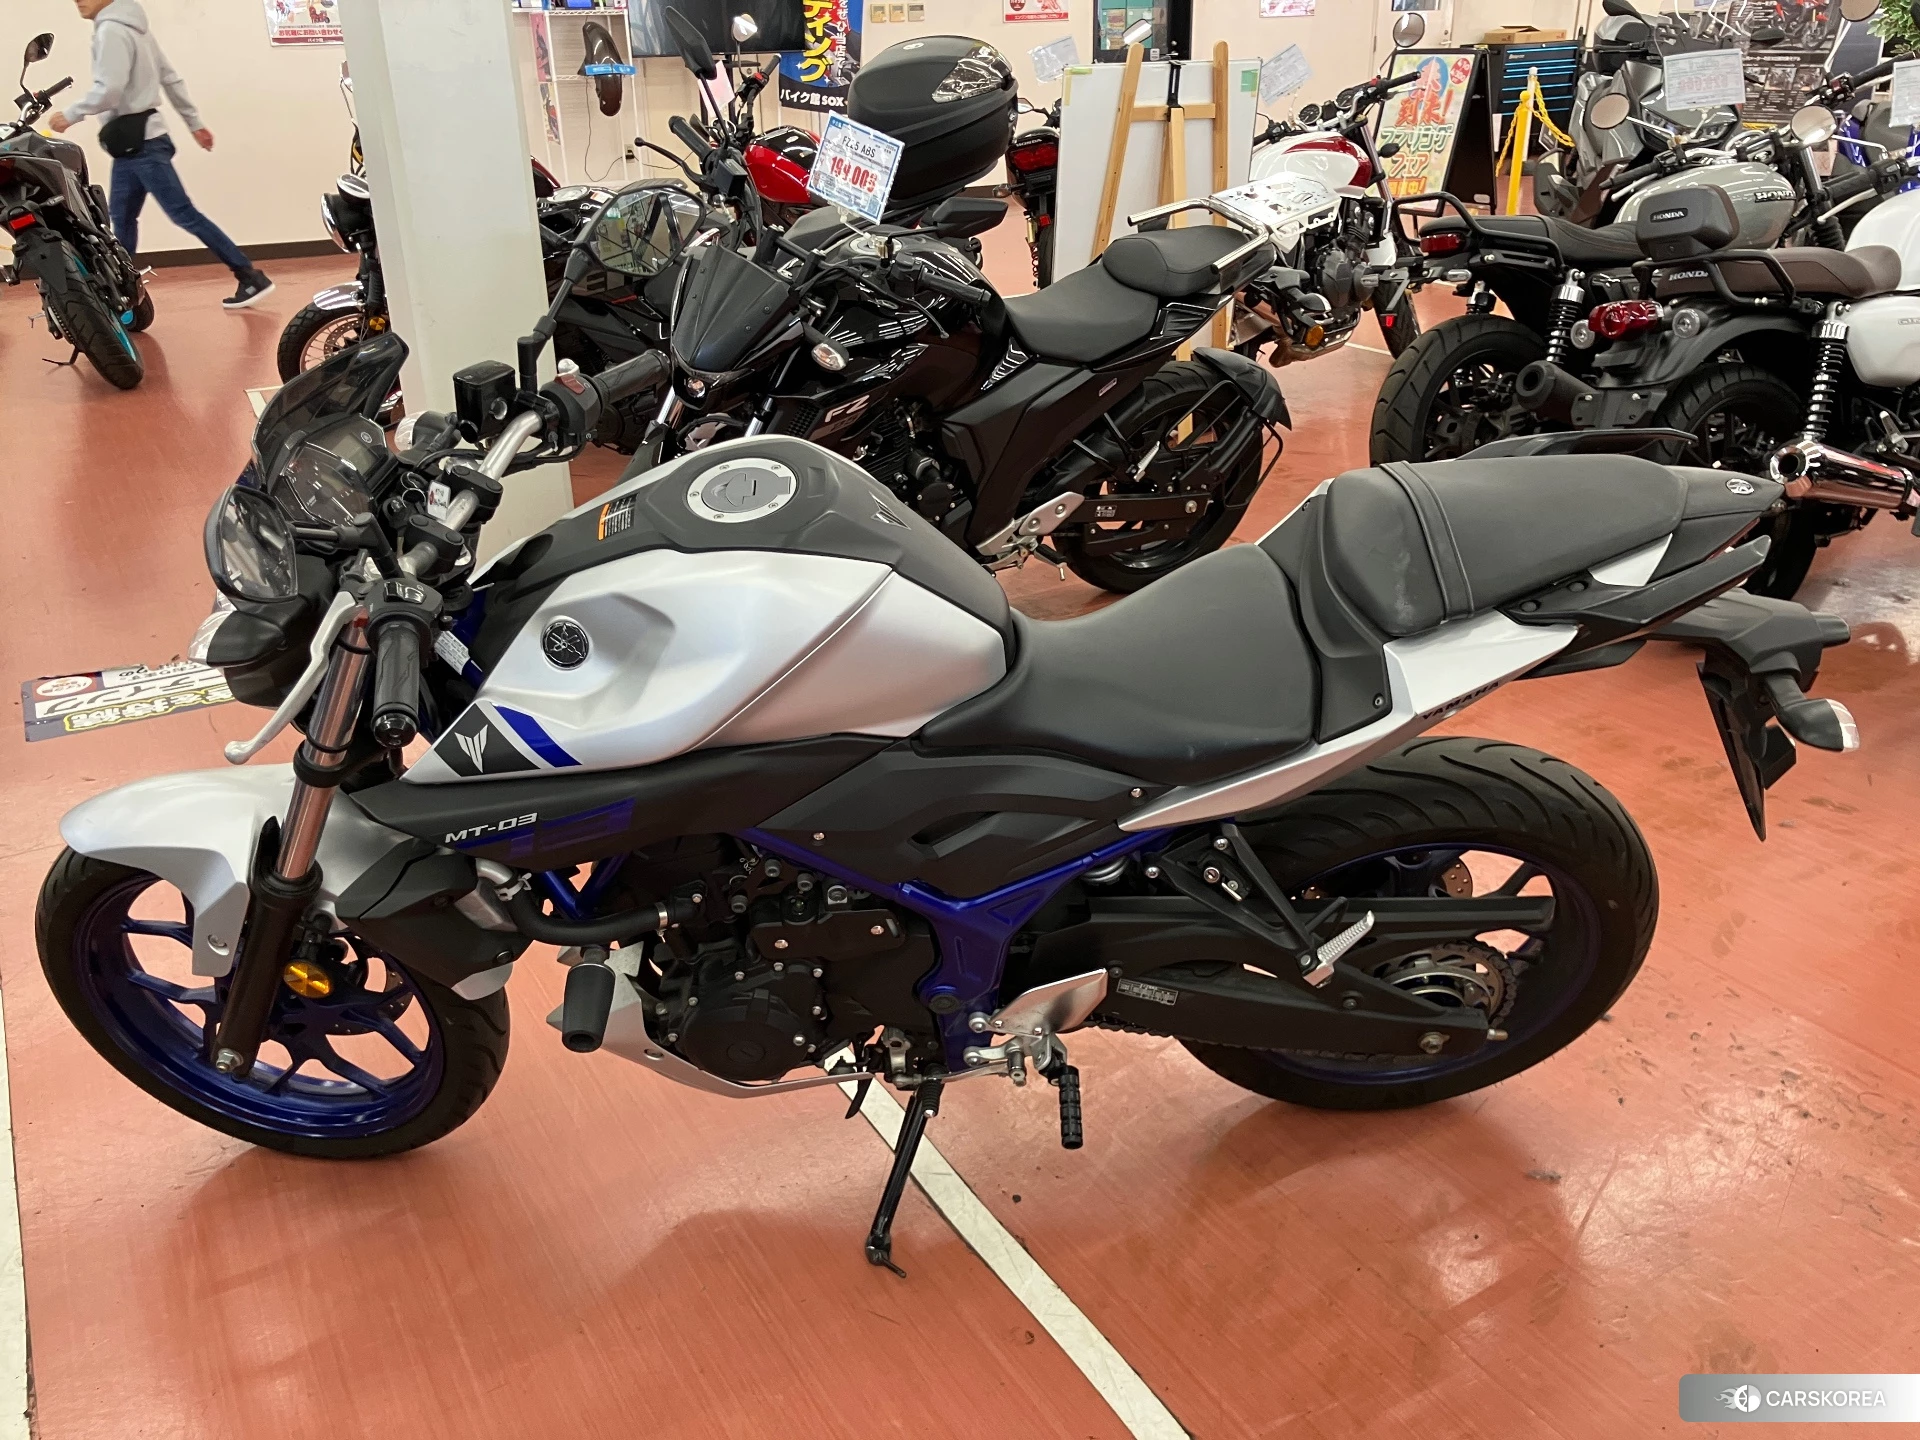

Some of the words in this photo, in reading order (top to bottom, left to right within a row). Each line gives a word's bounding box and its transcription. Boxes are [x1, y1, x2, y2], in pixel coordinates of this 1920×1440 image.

[861, 144, 876, 158] ABS
[1389, 152, 1430, 178] フェア
[1652, 210, 1685, 221] HONDA
[825, 394, 870, 423] FZ
[1423, 681, 1499, 719] YAMAHA
[445, 812, 538, 844] MT-03
